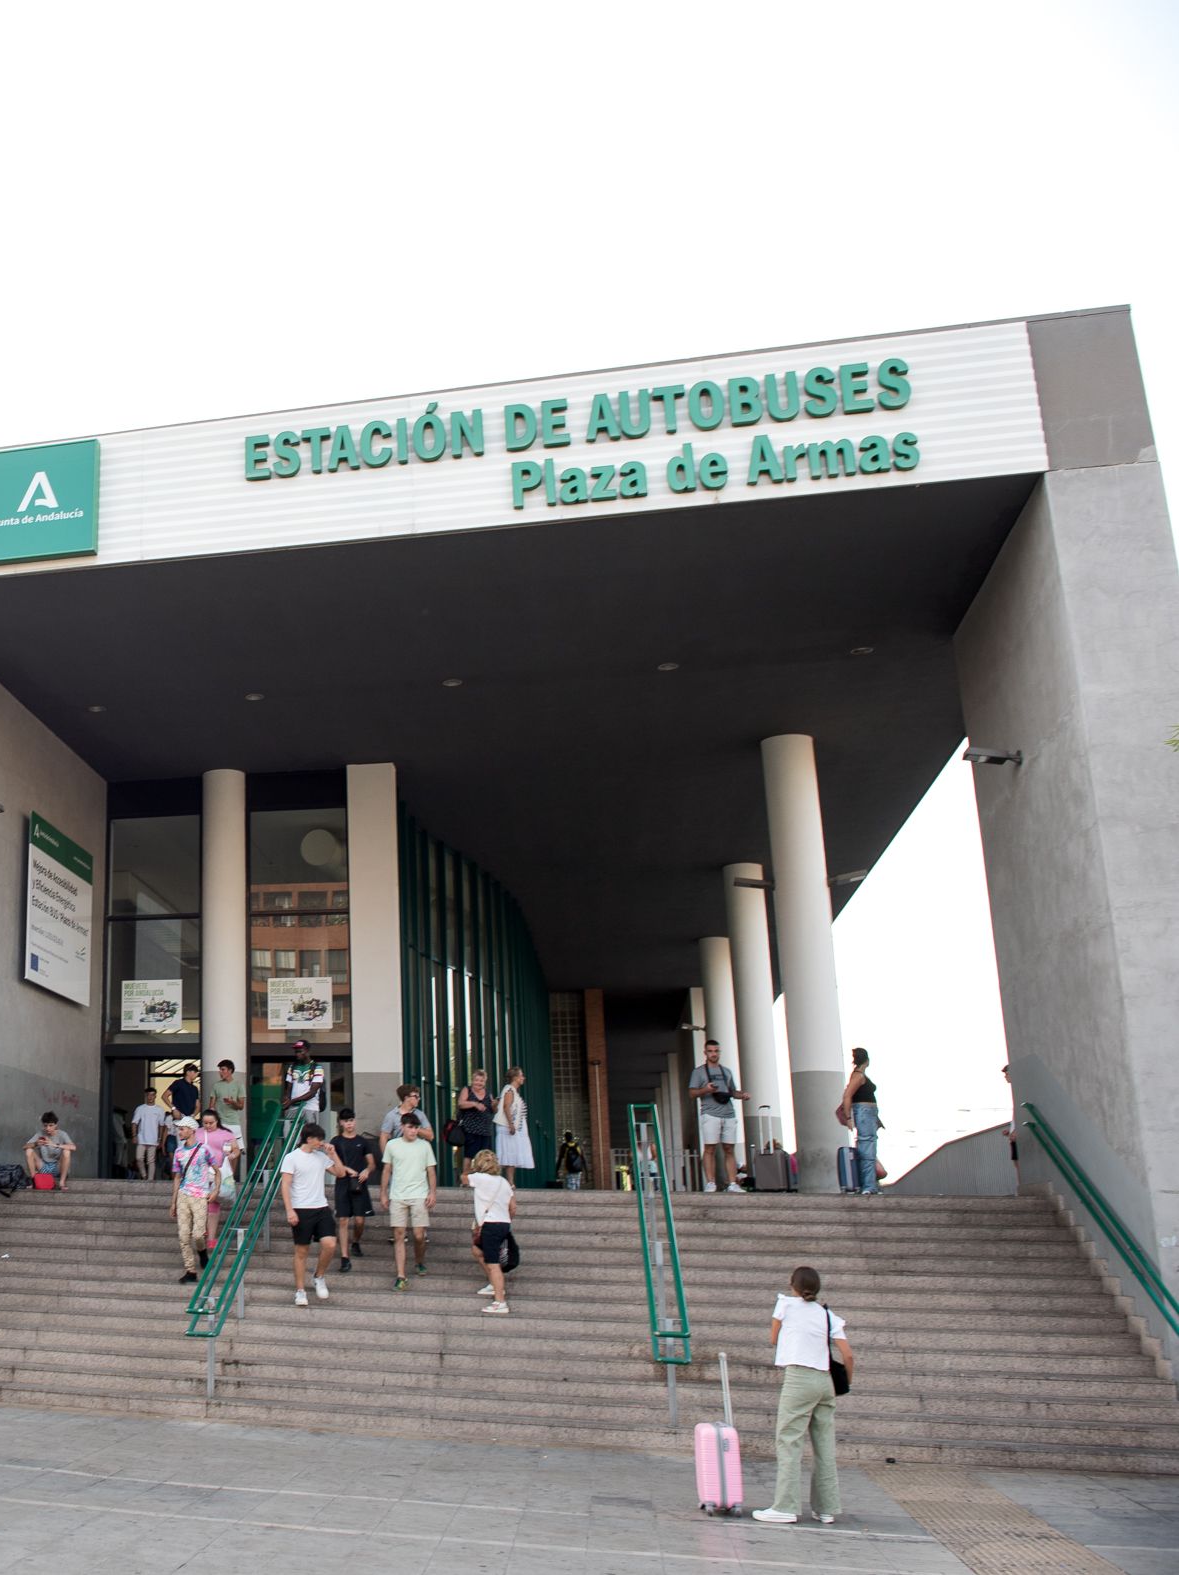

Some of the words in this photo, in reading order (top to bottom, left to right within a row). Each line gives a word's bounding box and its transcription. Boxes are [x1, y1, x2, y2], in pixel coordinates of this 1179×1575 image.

[245, 402, 484, 481] ESTACIÓN
[505, 398, 571, 452] DE
[587, 358, 912, 444] AUTOBUSES
[512, 458, 648, 510] Plaza
[667, 443, 728, 494] de
[747, 431, 921, 486] Armas
[21, 515, 34, 525] de
[35, 508, 84, 523] Andalucía
